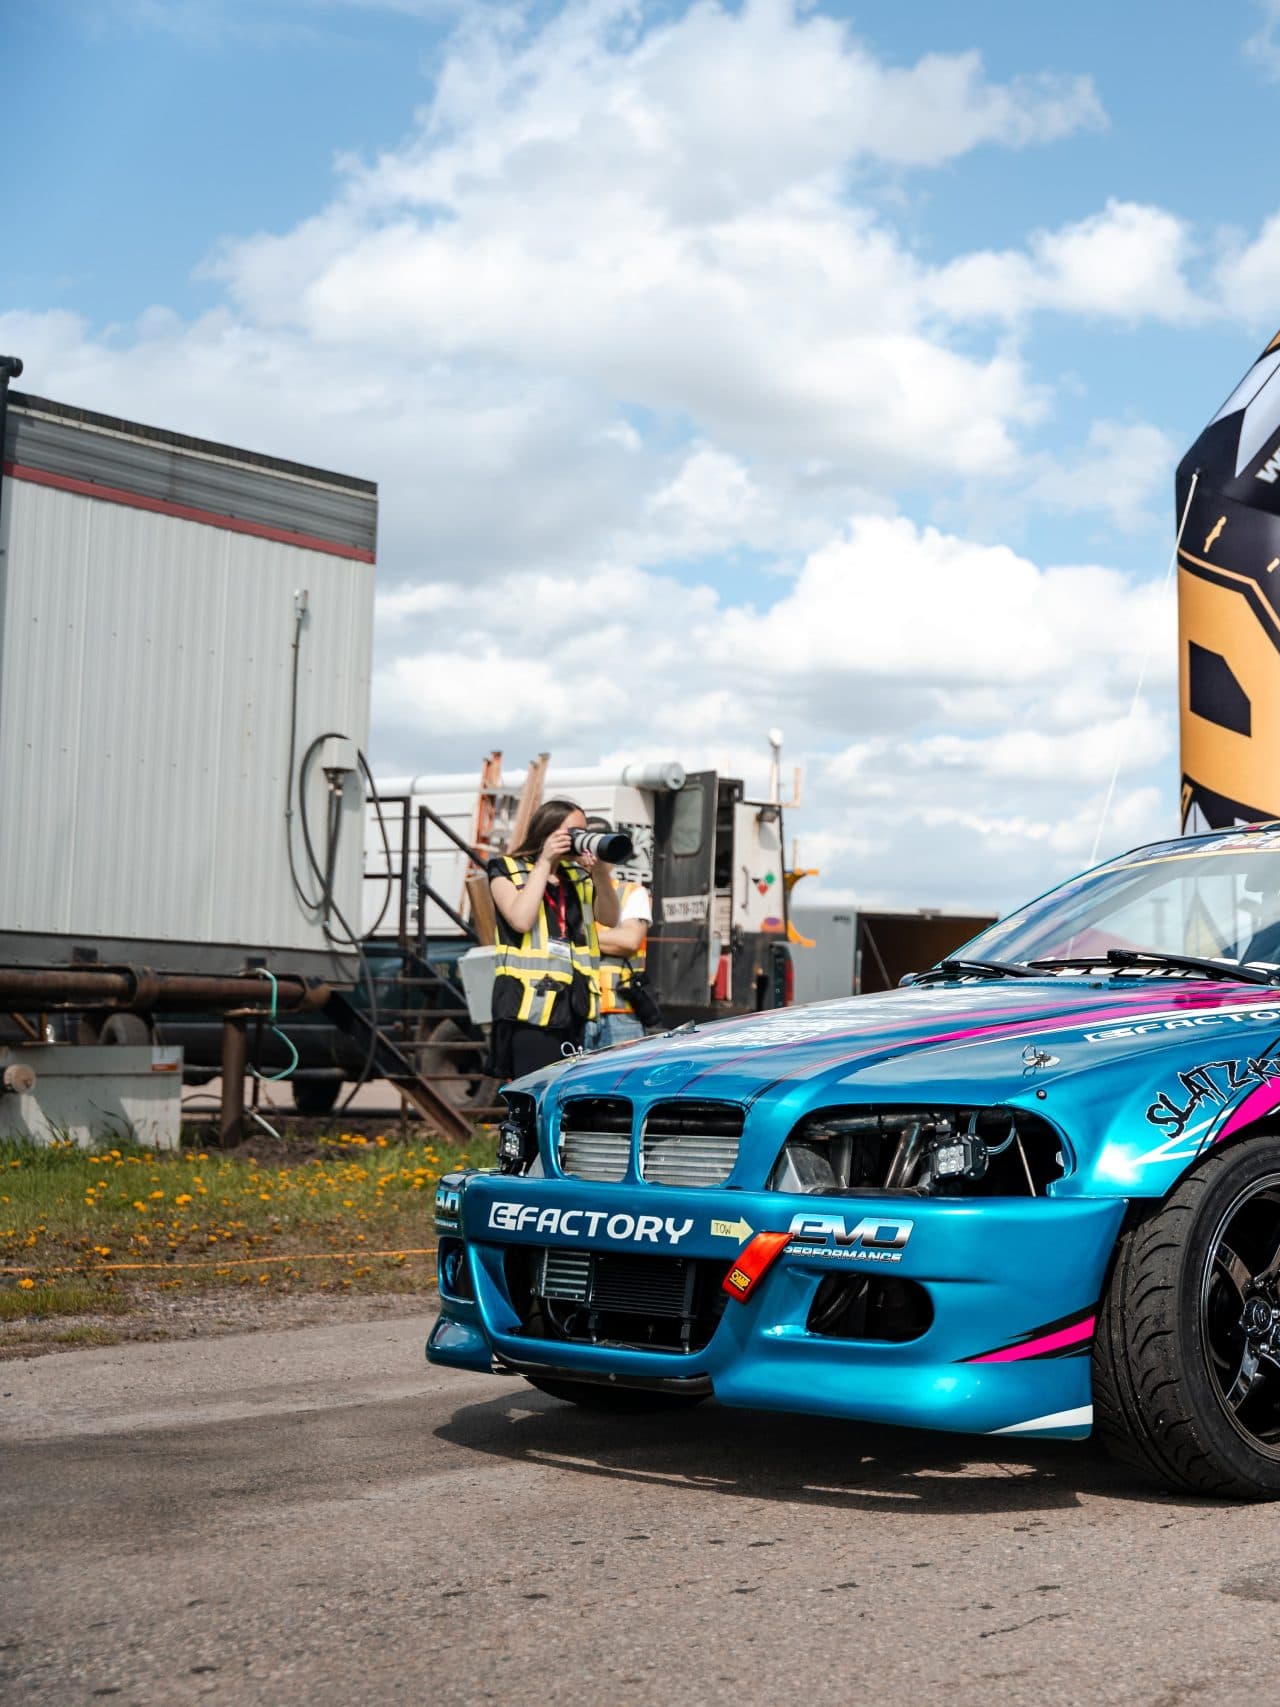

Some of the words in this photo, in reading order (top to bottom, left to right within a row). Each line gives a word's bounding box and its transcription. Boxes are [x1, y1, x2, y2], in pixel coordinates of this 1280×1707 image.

[713, 1222, 733, 1236] TOW
[787, 1212, 915, 1250] EVO
[782, 1245, 904, 1264] PERFORMANCE
[731, 1271, 749, 1288] OMP
